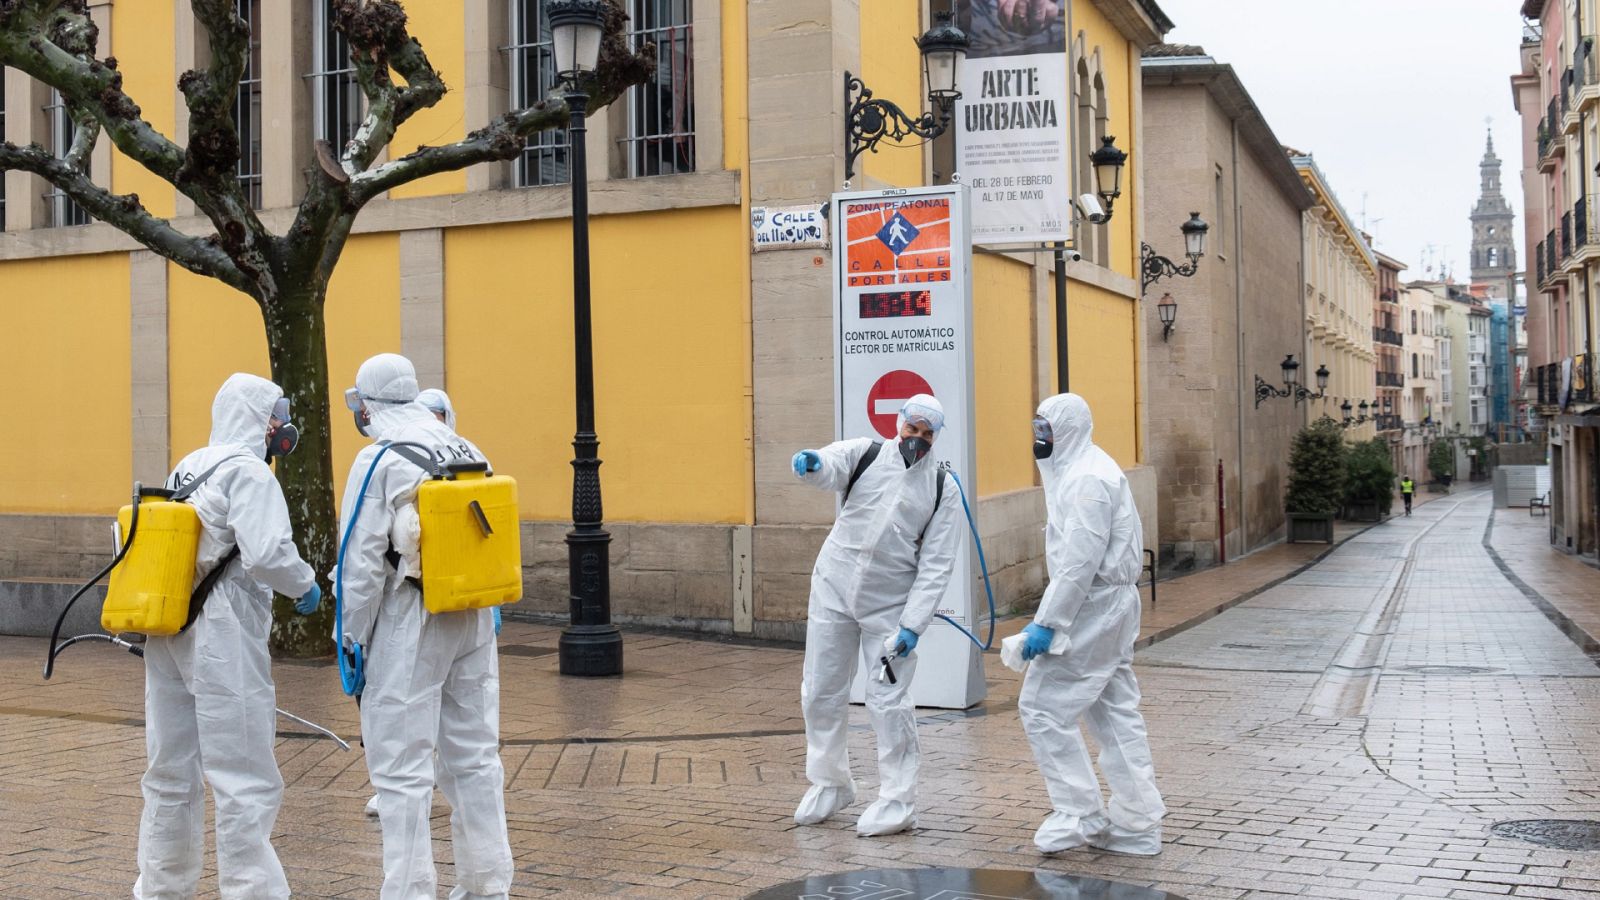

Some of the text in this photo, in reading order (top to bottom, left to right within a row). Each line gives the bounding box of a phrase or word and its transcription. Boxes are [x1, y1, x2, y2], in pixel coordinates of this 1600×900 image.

[981, 68, 1040, 98] ARTE
[964, 100, 1058, 132] URBANA
[973, 175, 1053, 188] DEL 28 DE FEBRERO
[982, 190, 1044, 202] AL 17 DE MAYO
[848, 199, 949, 213] ZONA PEATONAL
[772, 212, 815, 226] CALLE
[757, 232, 770, 242] DEL
[852, 256, 945, 270] CALLE
[851, 273, 949, 285] PORTALES
[862, 291, 931, 317] 13:14
[845, 326, 955, 341] CONTROL AUTOMÁTICO
[845, 340, 955, 354] LECTOR DE MATRÍCULAS
